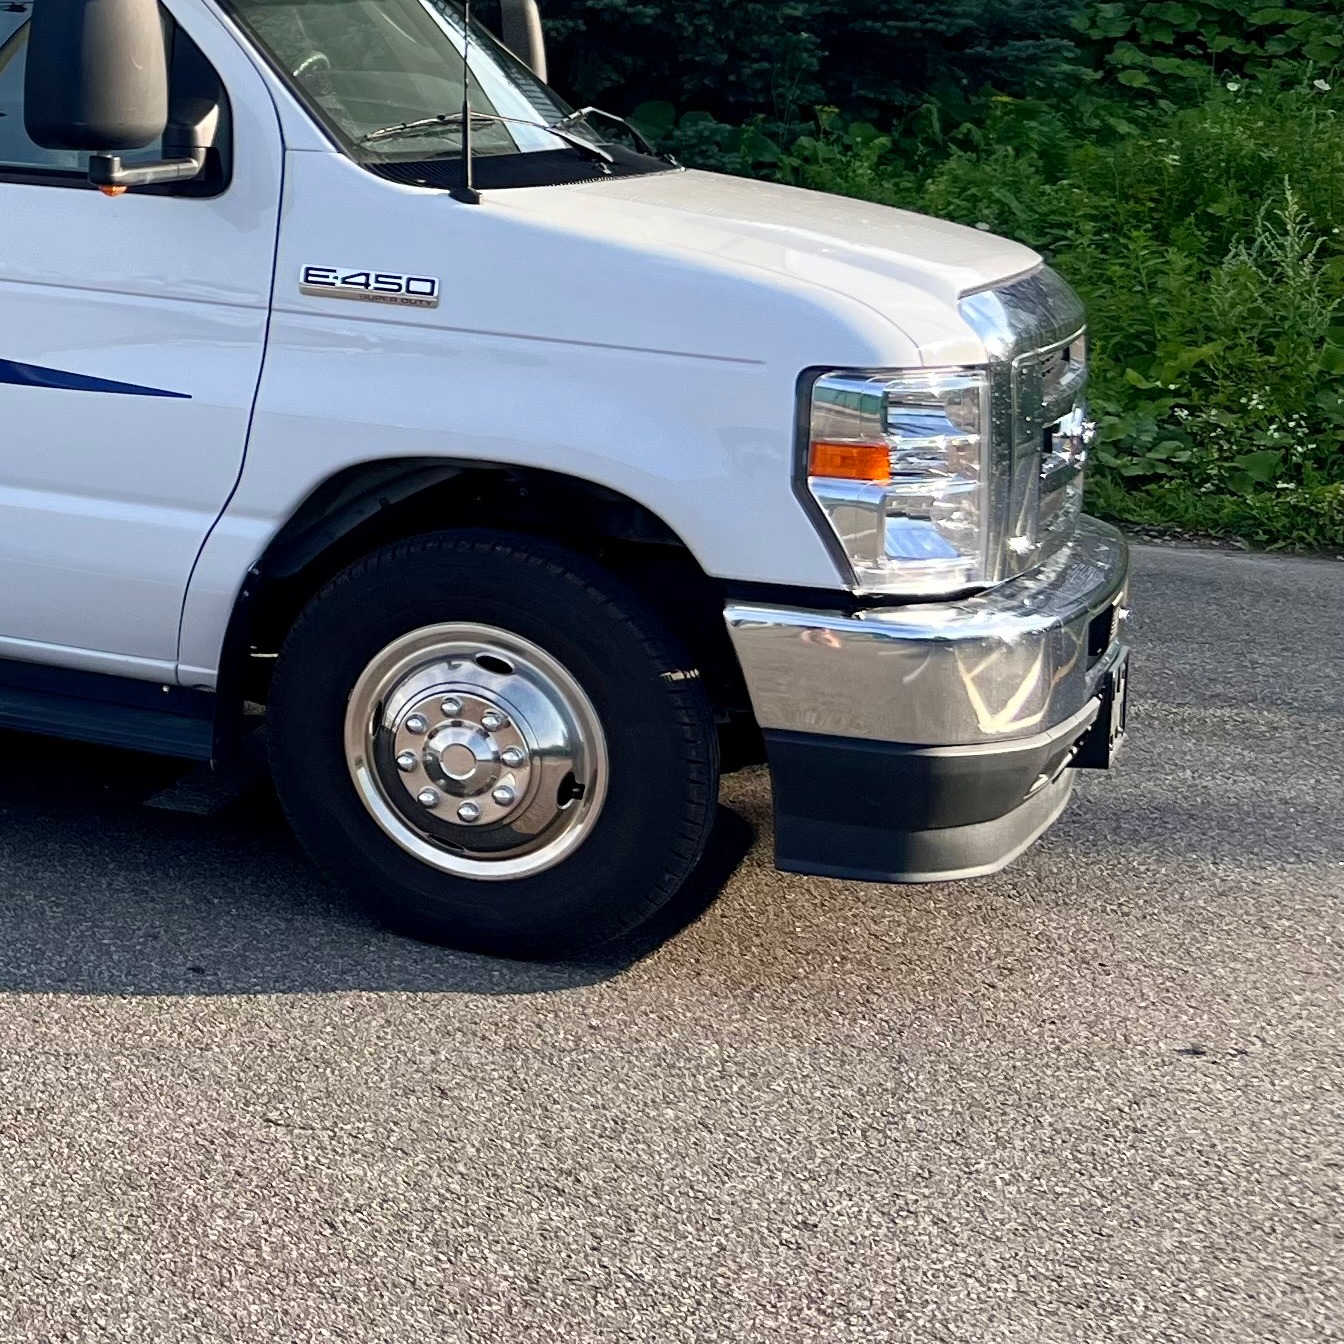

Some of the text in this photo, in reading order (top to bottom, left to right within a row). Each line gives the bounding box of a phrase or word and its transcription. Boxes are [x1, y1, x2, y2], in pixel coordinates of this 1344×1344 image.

[304, 267, 436, 296] E-450
[359, 293, 433, 306] SUPER DUTY
